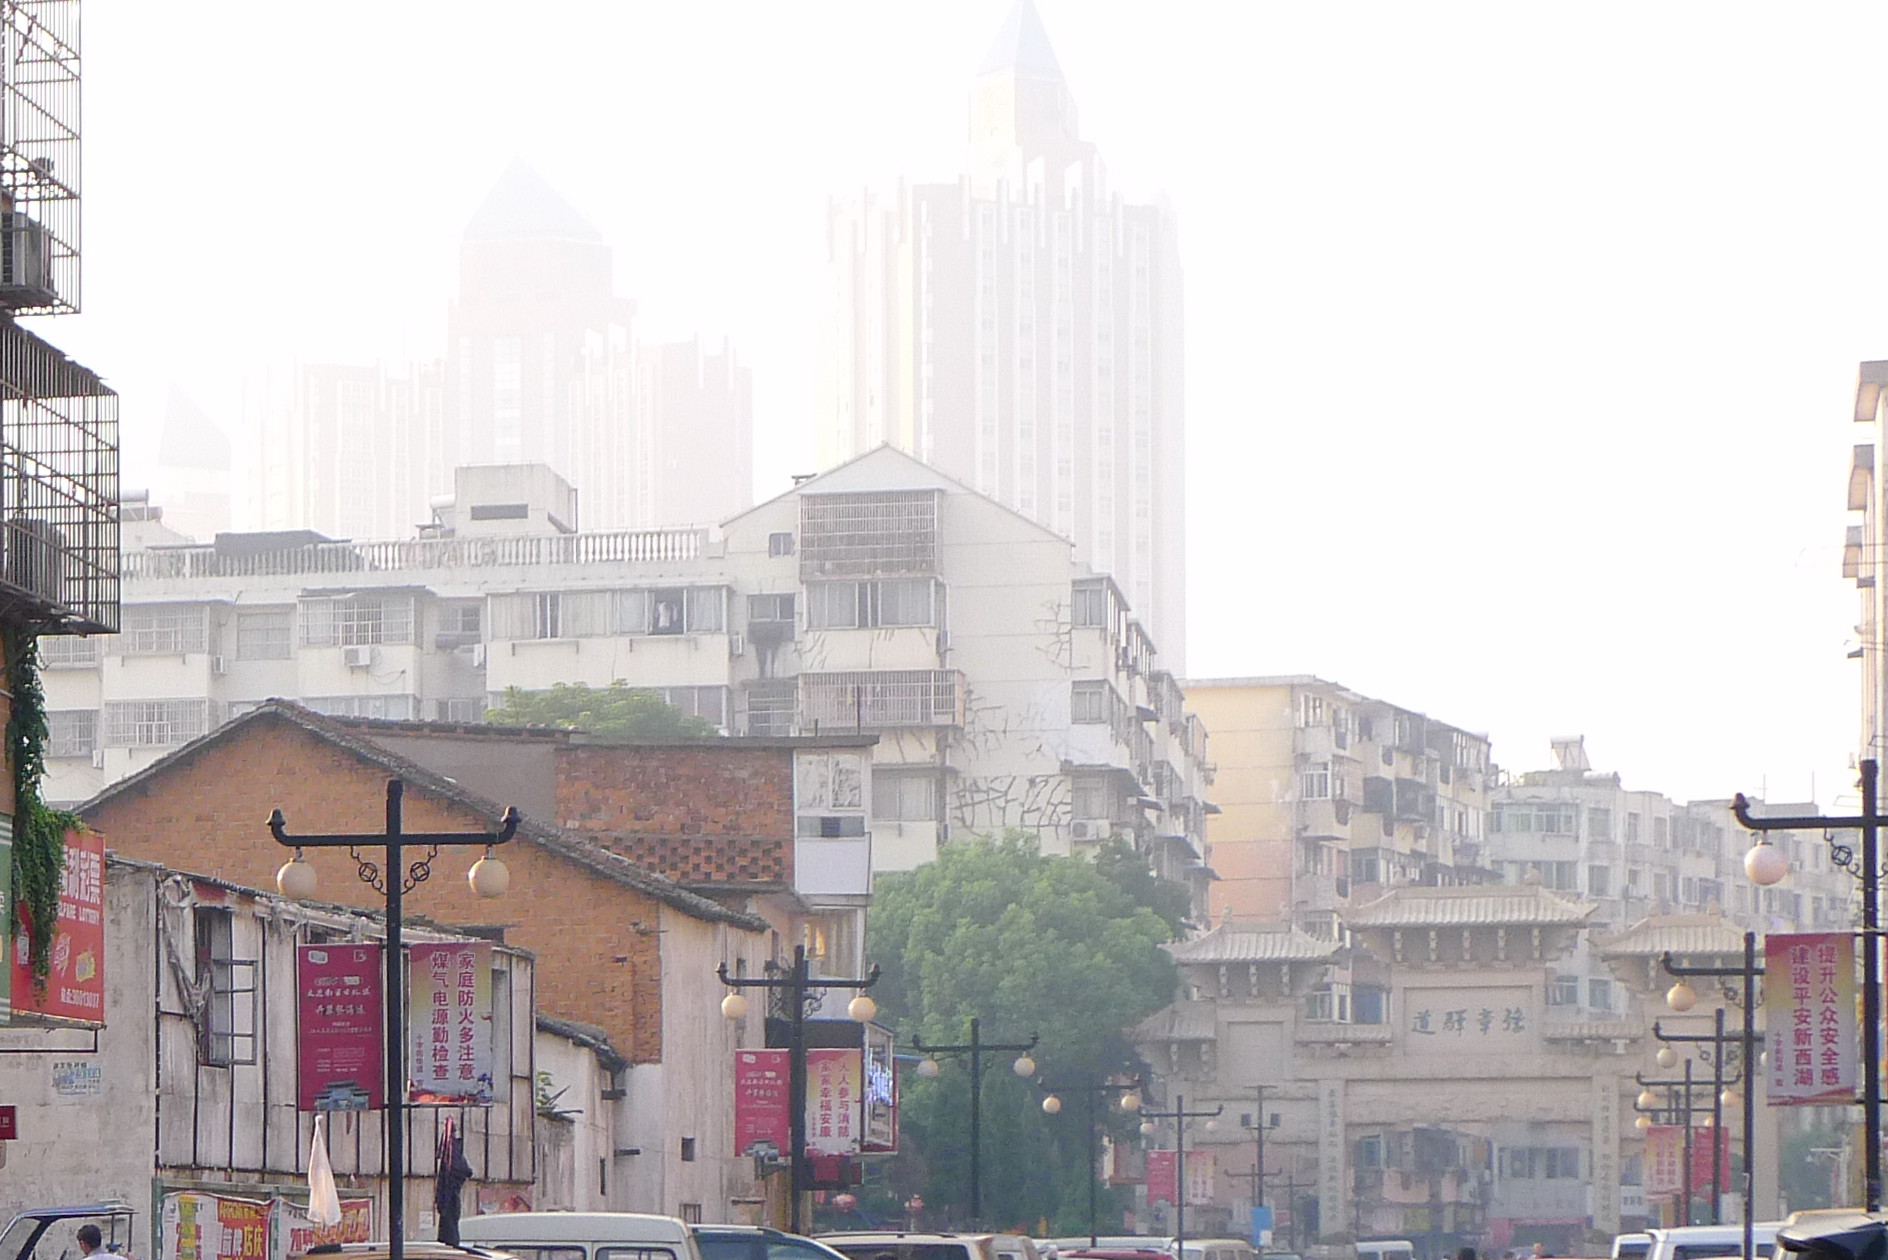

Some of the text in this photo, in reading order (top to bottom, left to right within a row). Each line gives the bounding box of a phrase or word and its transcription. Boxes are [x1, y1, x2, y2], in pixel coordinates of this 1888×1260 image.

[431, 951, 450, 1081] 煤气电源勤检查
[457, 951, 476, 1081] 家庭防火多注意
[1792, 945, 1814, 1087] 建设平安新西湖
[1818, 945, 1840, 1086] 提升公众安全感
